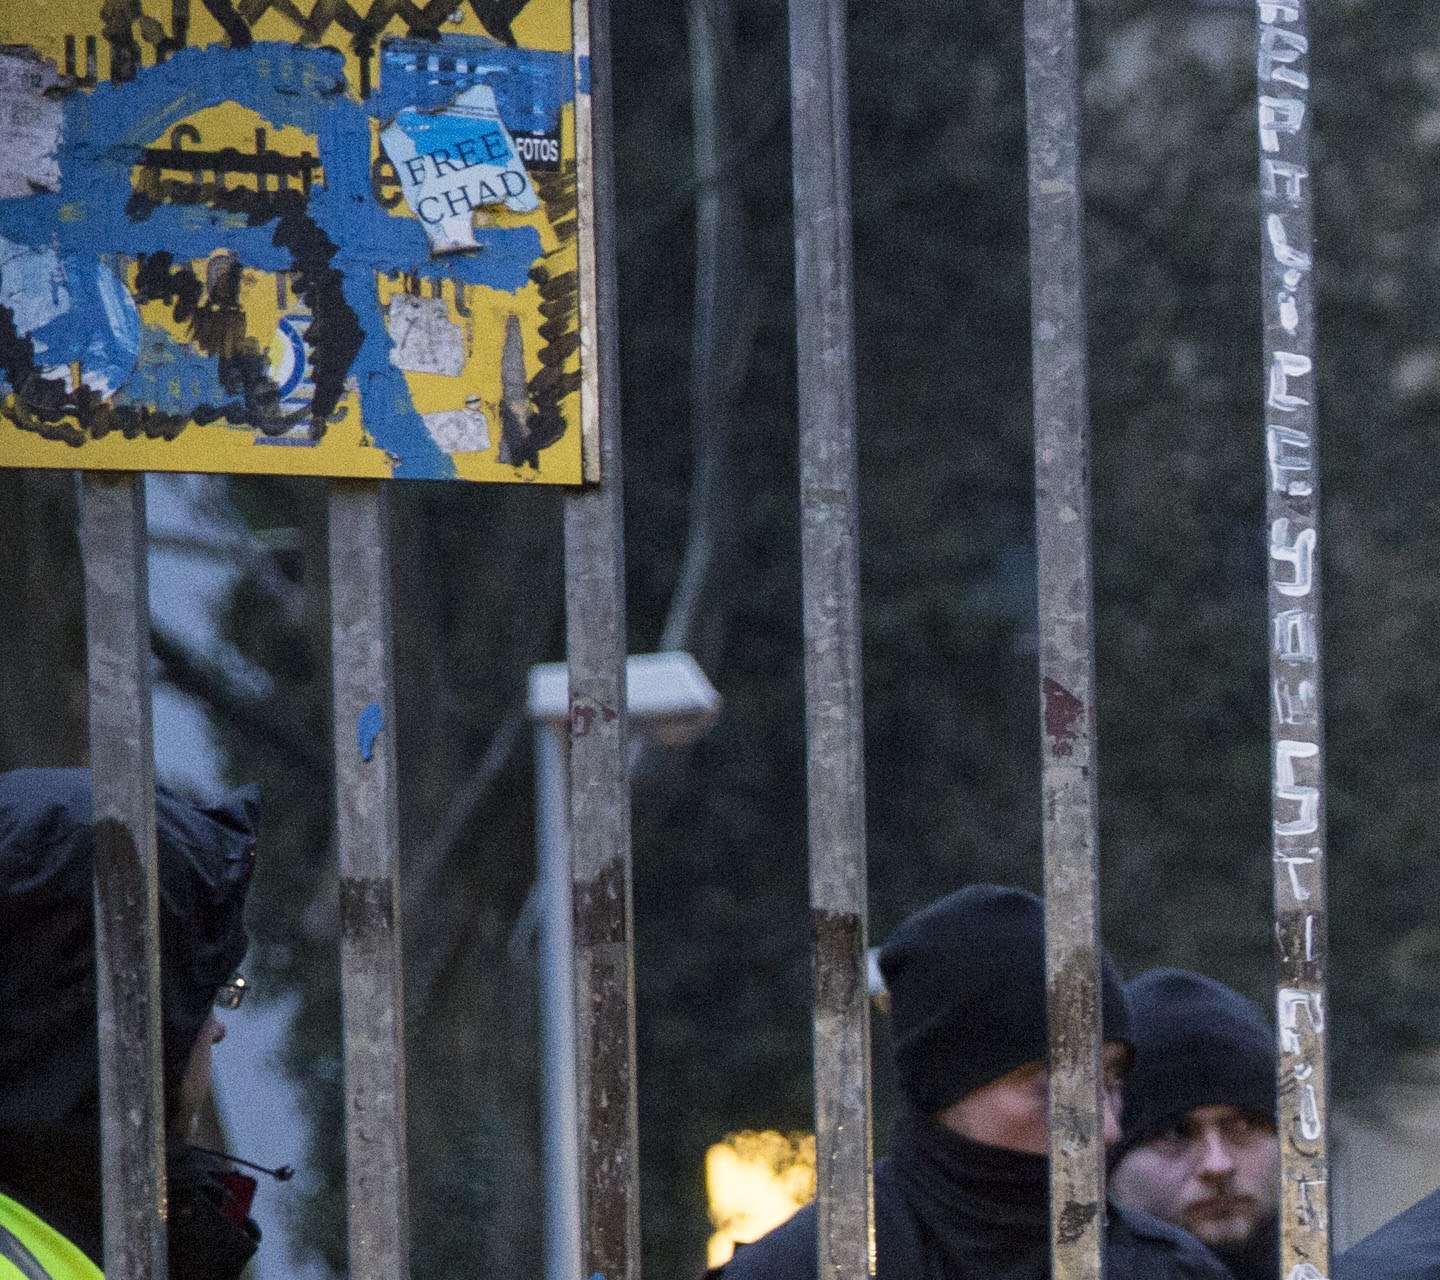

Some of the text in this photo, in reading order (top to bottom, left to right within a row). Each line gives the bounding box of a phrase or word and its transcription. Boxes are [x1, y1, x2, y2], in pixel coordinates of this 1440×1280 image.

[402, 130, 509, 187] FREE
[515, 136, 560, 162] FOTOS
[416, 169, 528, 226] CHAD
